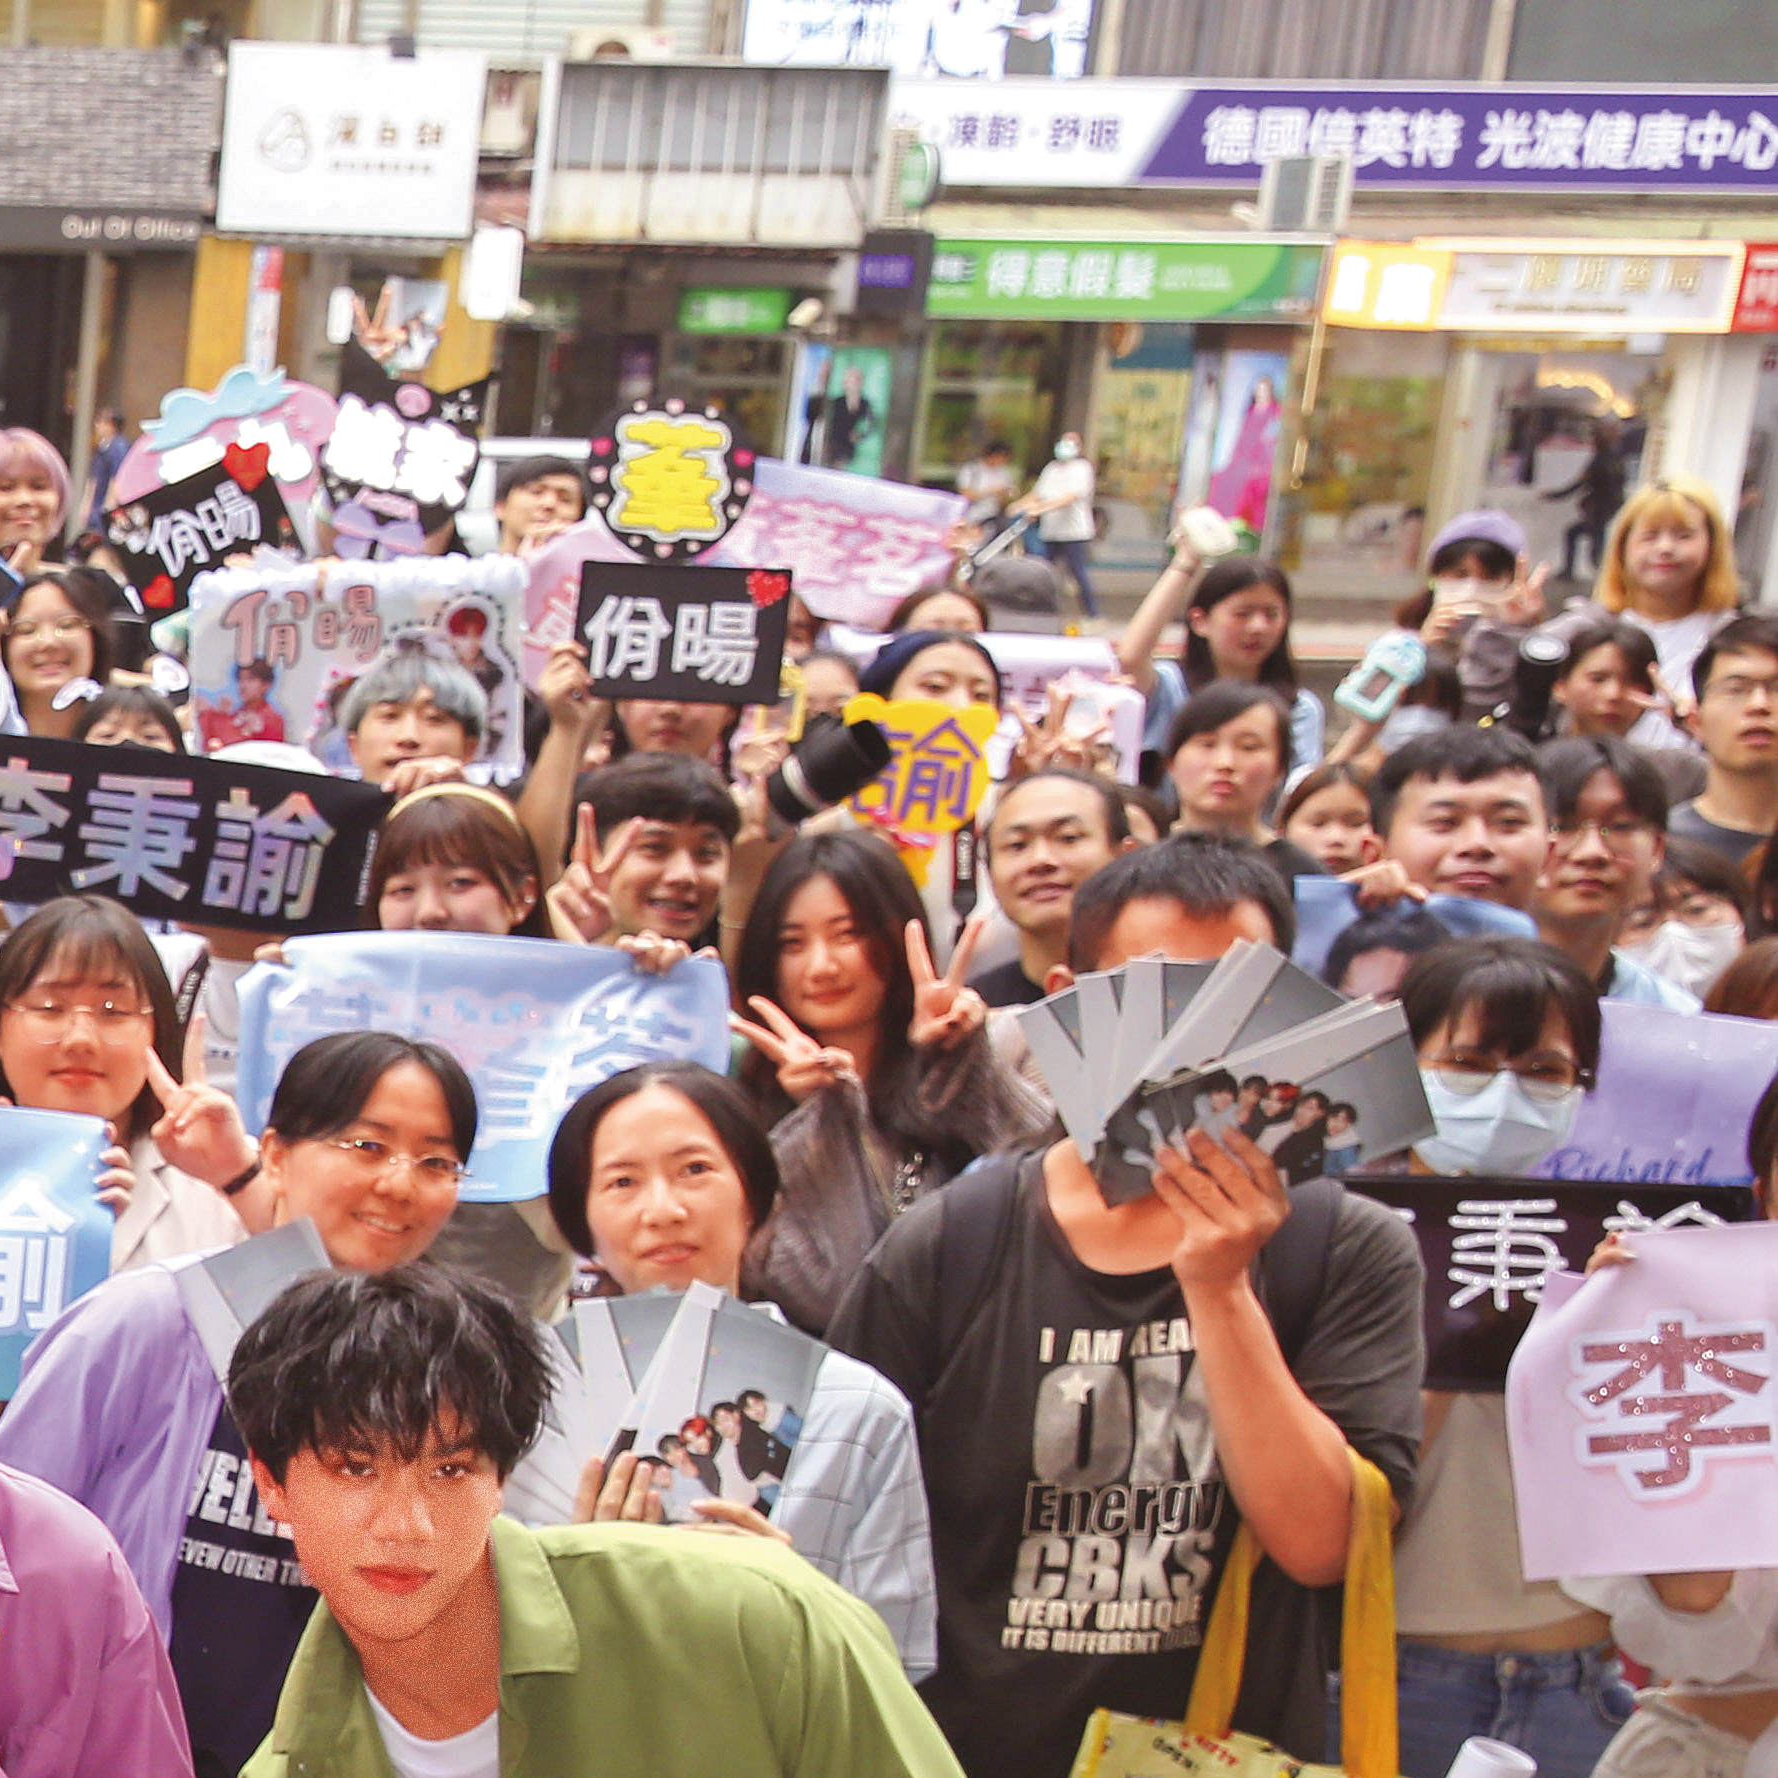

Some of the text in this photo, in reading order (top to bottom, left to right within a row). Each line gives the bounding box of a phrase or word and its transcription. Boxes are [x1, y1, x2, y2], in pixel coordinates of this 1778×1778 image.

[1581, 1320, 1771, 1490] 李
[1022, 1479, 1227, 1539] Energy
[1011, 1533, 1213, 1602] CBKS
